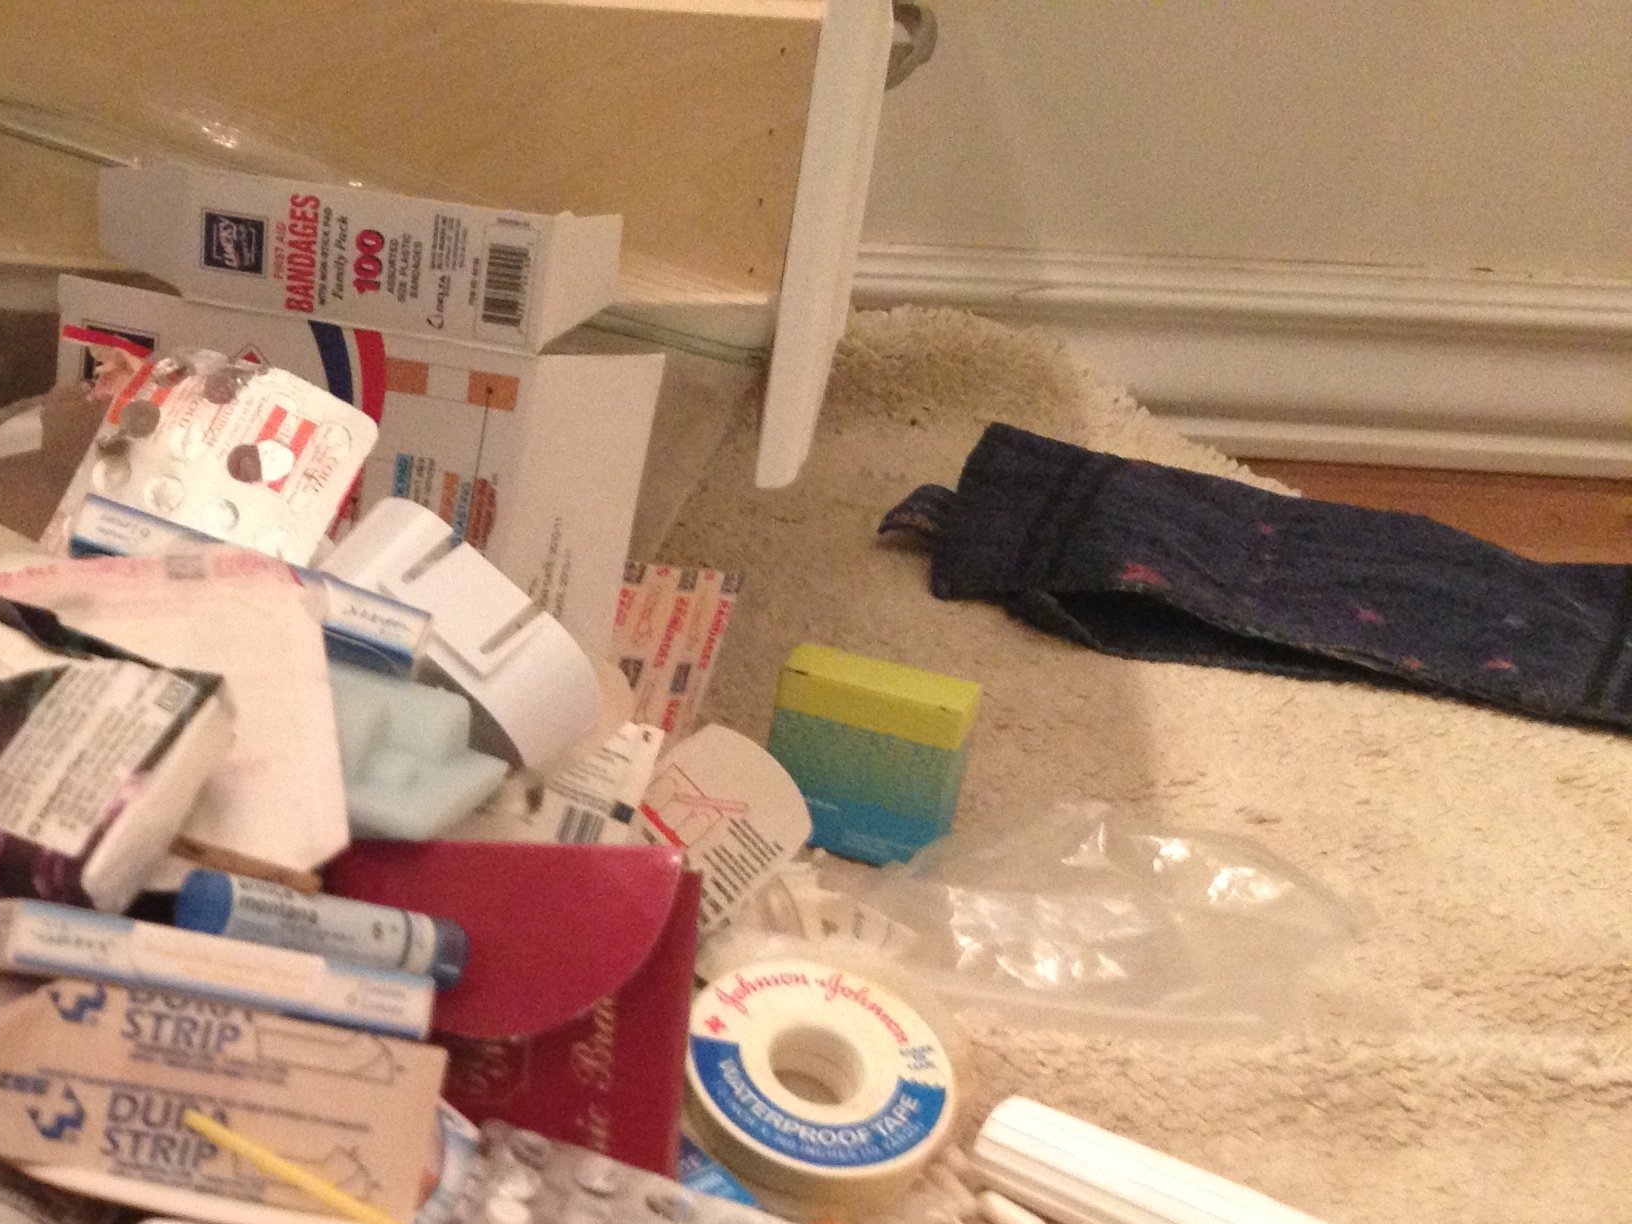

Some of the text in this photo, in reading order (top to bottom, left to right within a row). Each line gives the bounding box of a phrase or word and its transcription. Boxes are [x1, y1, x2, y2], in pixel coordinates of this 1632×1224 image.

[285, 194, 321, 313] BANDAGES
[331, 215, 348, 300] Family Pack
[352, 229, 385, 294] 100
[120, 1008, 242, 1053] STRIP
[719, 1058, 871, 1146] WATERPROOF
[871, 1093, 919, 1139] TAPE
[100, 1127, 220, 1166] STRIP
